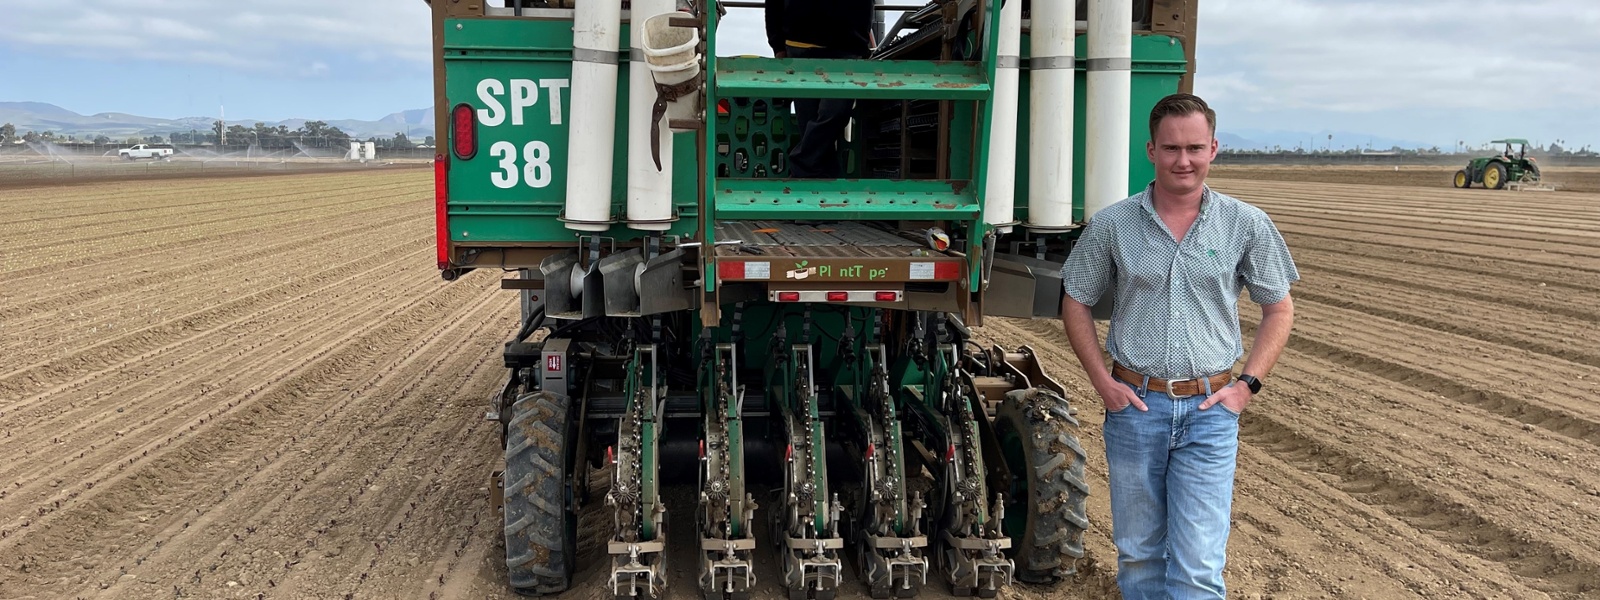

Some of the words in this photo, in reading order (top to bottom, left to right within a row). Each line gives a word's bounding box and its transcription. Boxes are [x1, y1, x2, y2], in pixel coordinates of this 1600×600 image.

[476, 78, 569, 127] SPT
[489, 141, 552, 189] 38
[819, 264, 886, 281] PlntTpe
